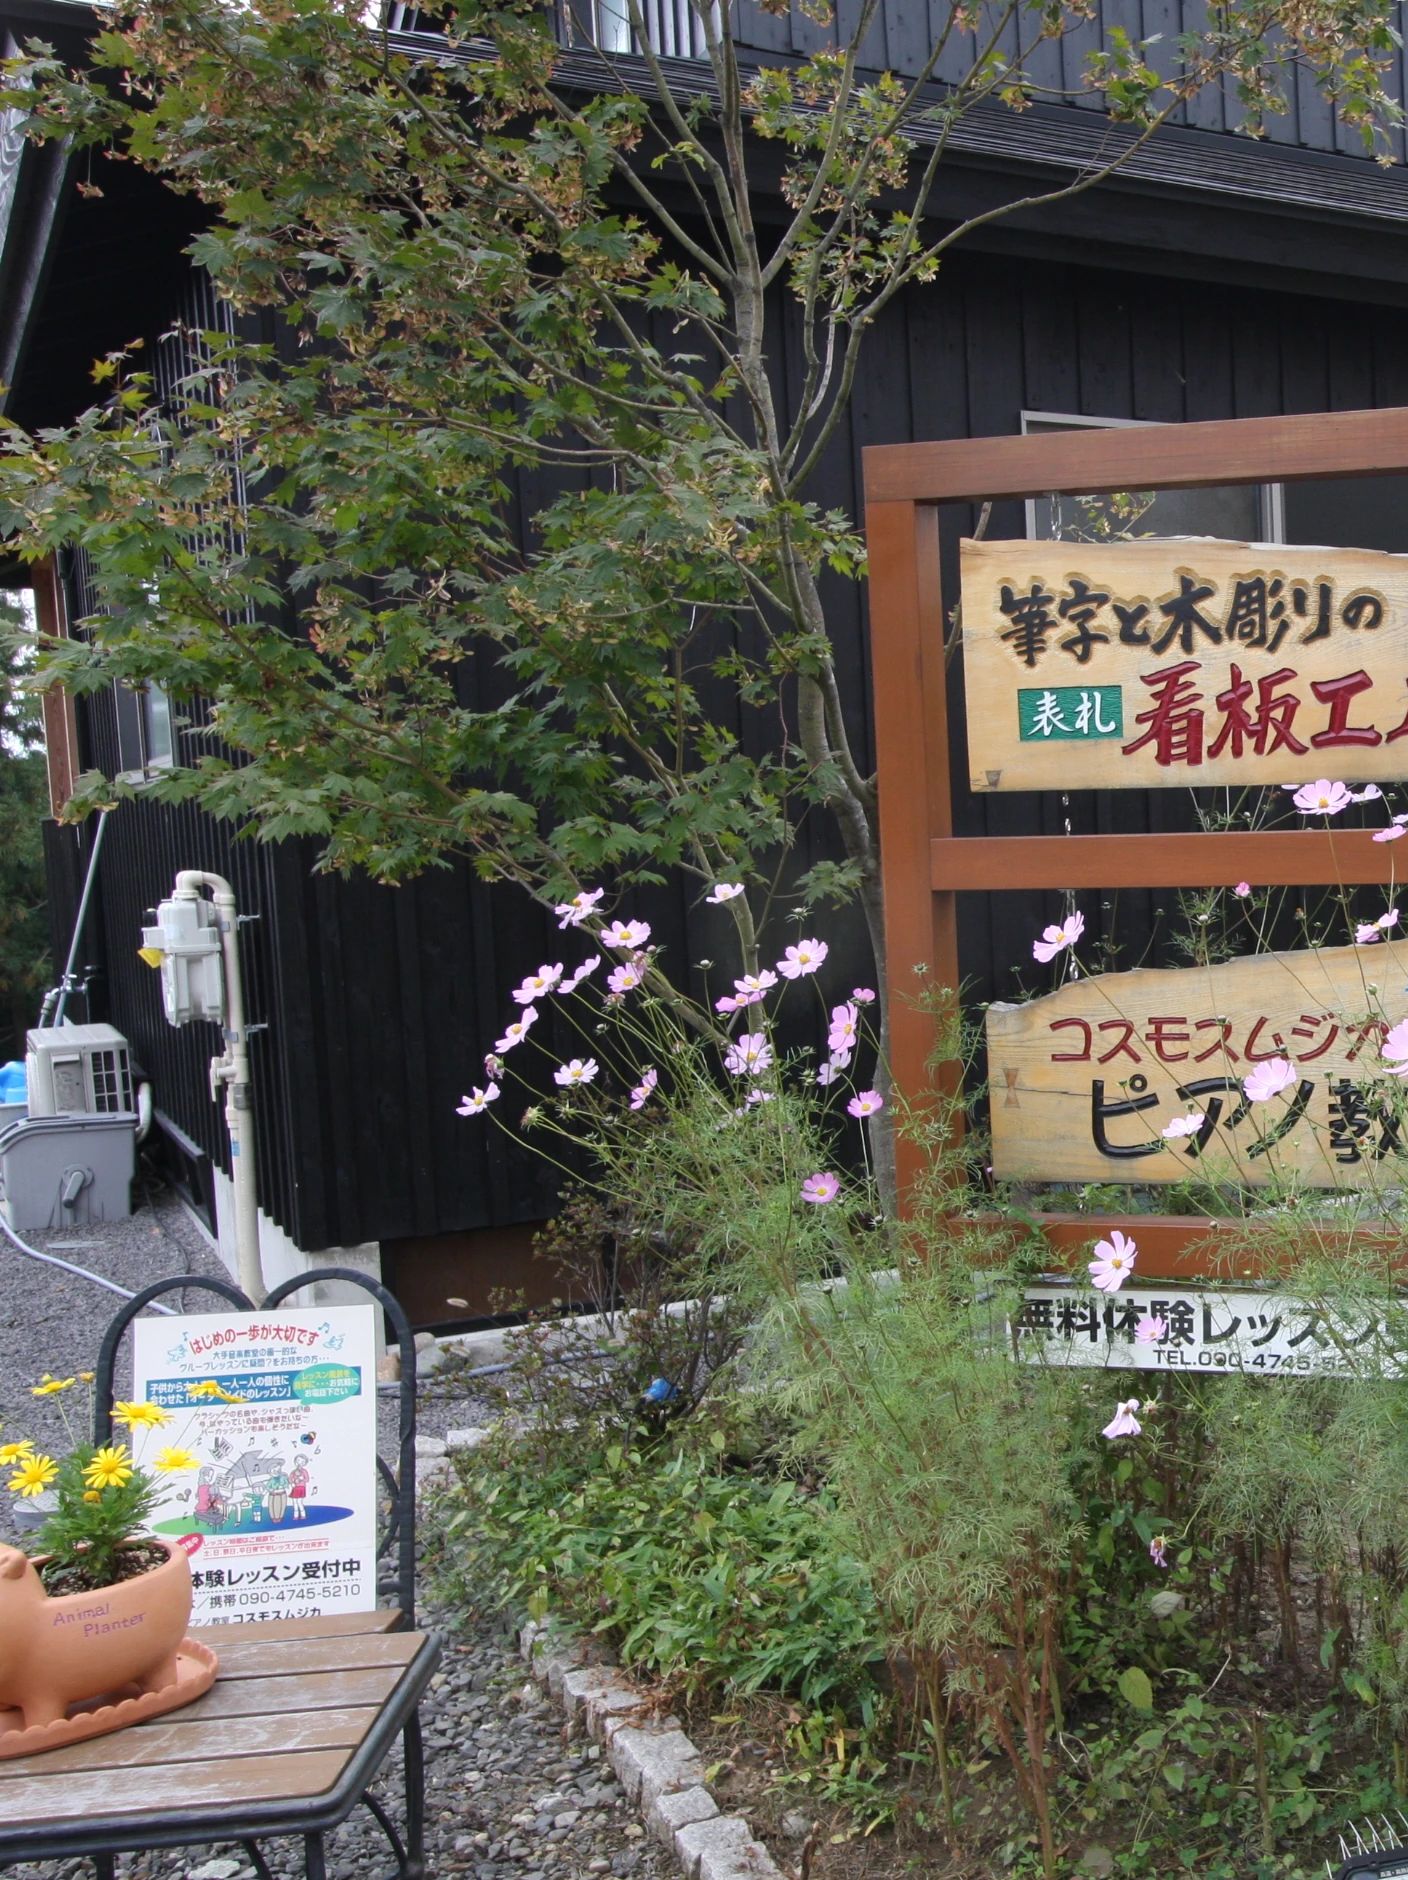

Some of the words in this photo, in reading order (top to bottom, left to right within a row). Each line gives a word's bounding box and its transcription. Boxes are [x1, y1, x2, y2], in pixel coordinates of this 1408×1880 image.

[1000, 574, 1386, 667] 筆字と木彫りの
[1028, 690, 1118, 737] 表札
[189, 1324, 320, 1355] はじめの一歩が大切です
[239, 1583, 361, 1606] 090-4745-5210
[52, 1602, 110, 1626] Animal
[83, 1611, 146, 1638] Planter
